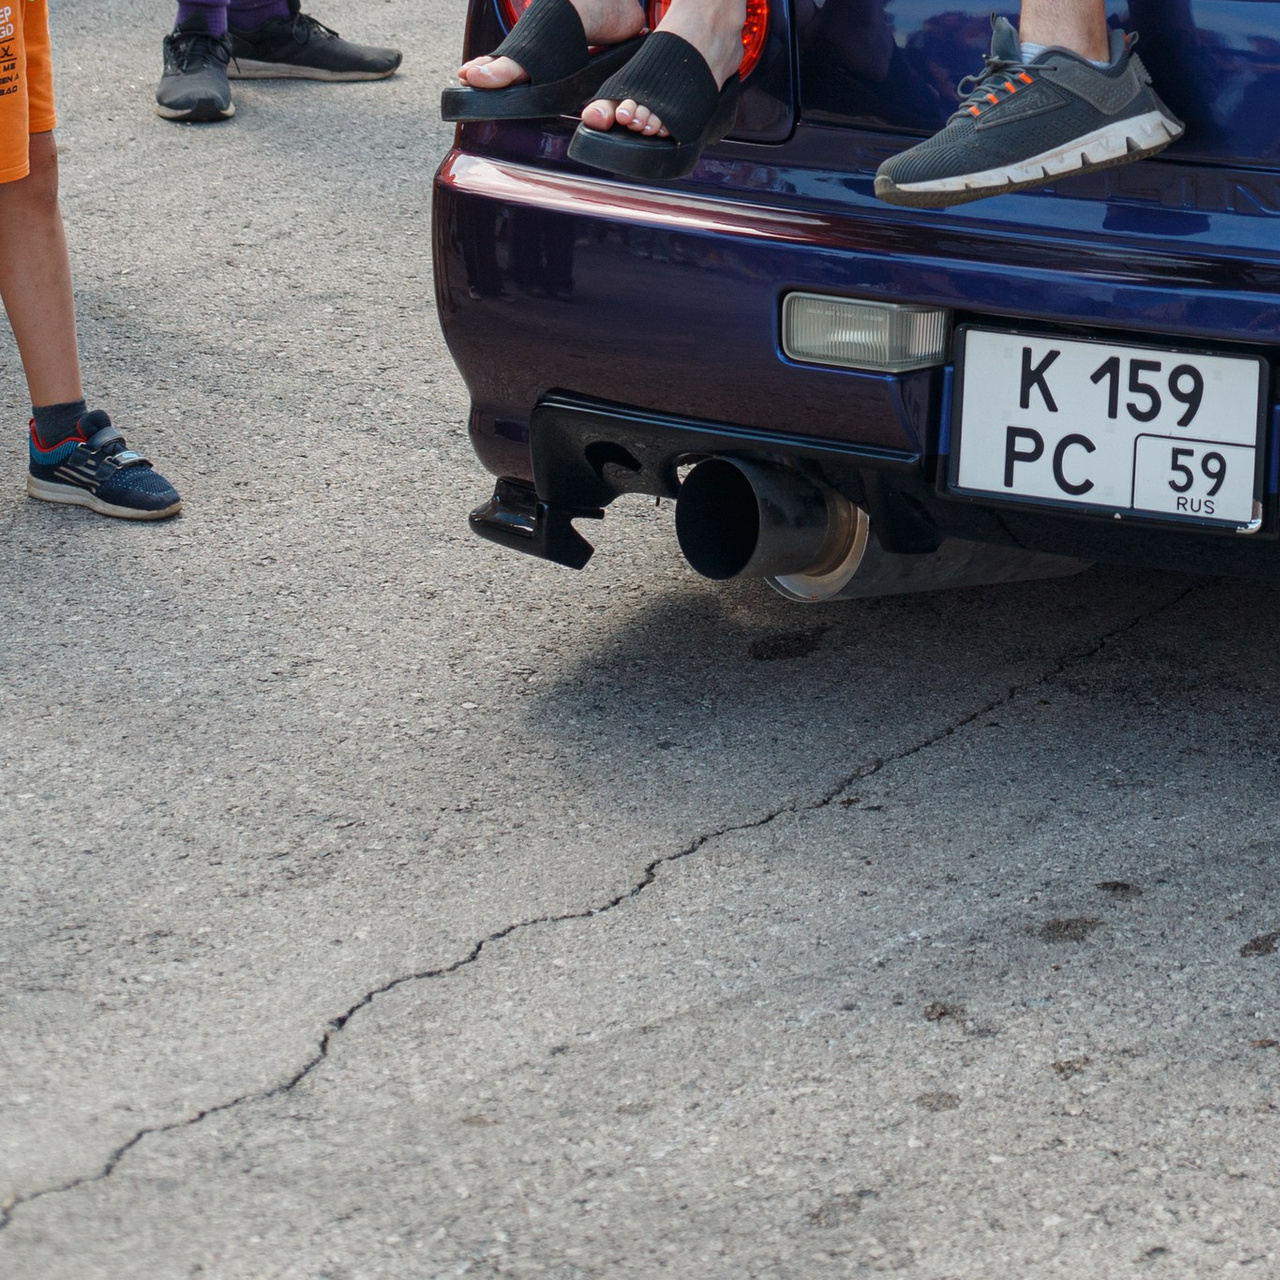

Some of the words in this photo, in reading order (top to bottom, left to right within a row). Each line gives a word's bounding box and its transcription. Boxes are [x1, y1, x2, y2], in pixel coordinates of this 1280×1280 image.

[1089, 356, 1205, 428] 159
[1168, 446, 1227, 497] 59
[1176, 496, 1216, 515] RUS
